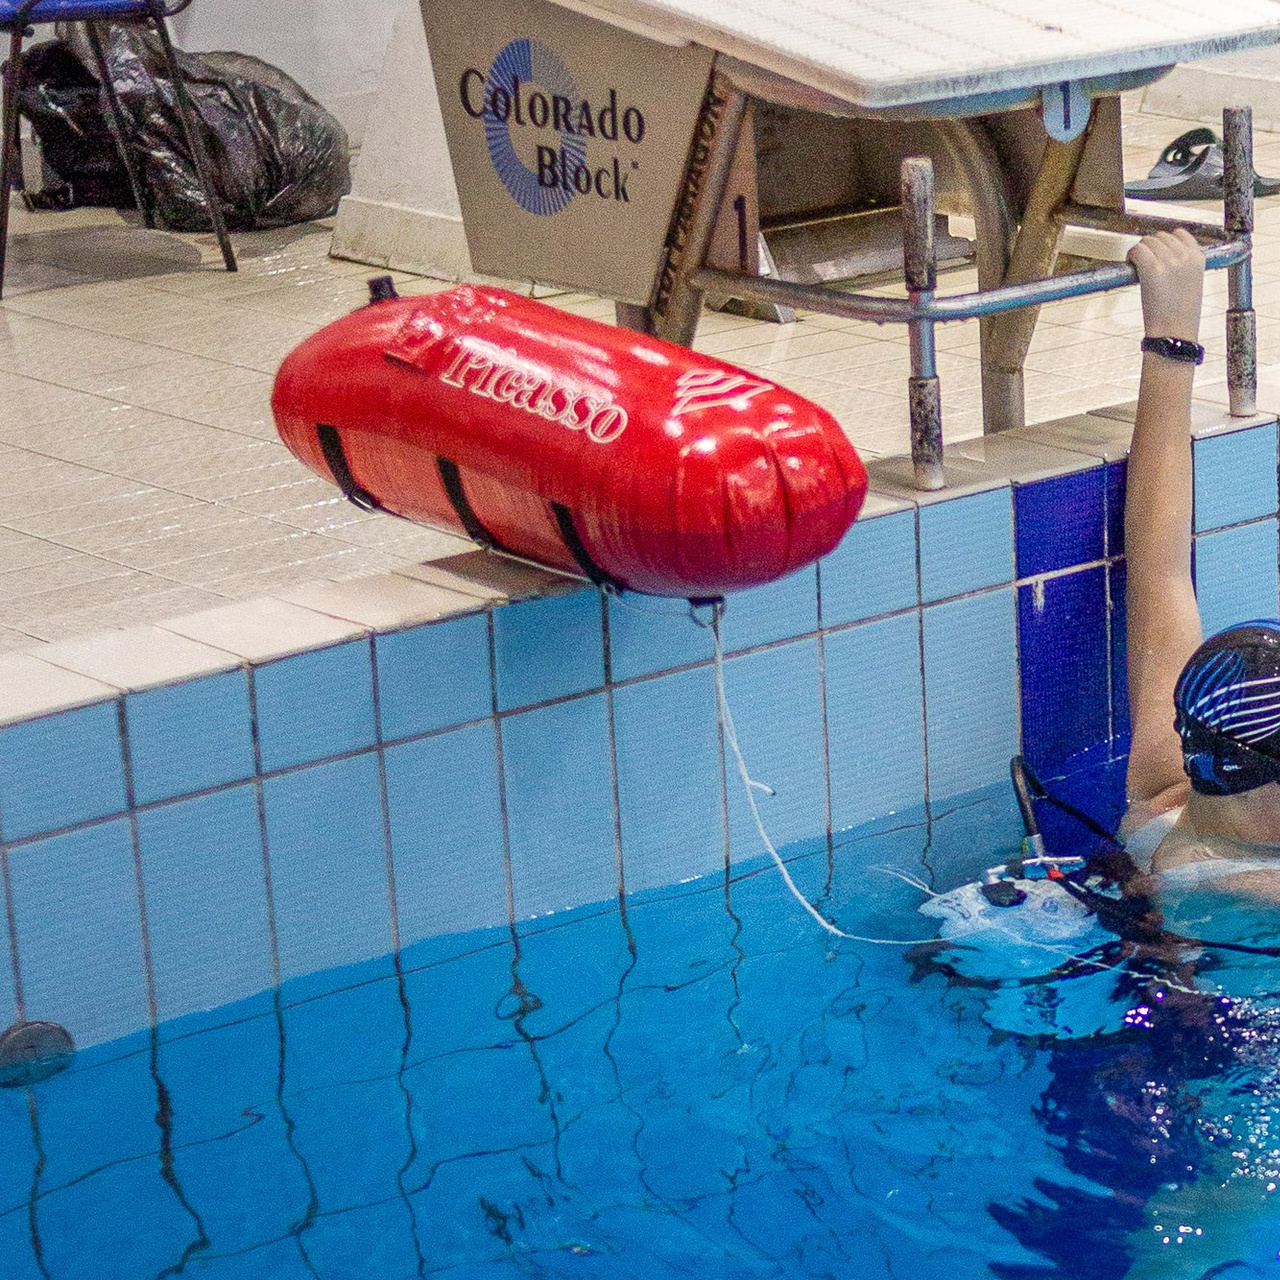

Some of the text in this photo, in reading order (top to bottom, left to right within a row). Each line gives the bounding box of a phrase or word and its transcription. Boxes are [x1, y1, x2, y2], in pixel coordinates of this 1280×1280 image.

[1060, 81, 1071, 131] 1
[733, 194, 748, 270] 1
[440, 336, 629, 444] Picasso
